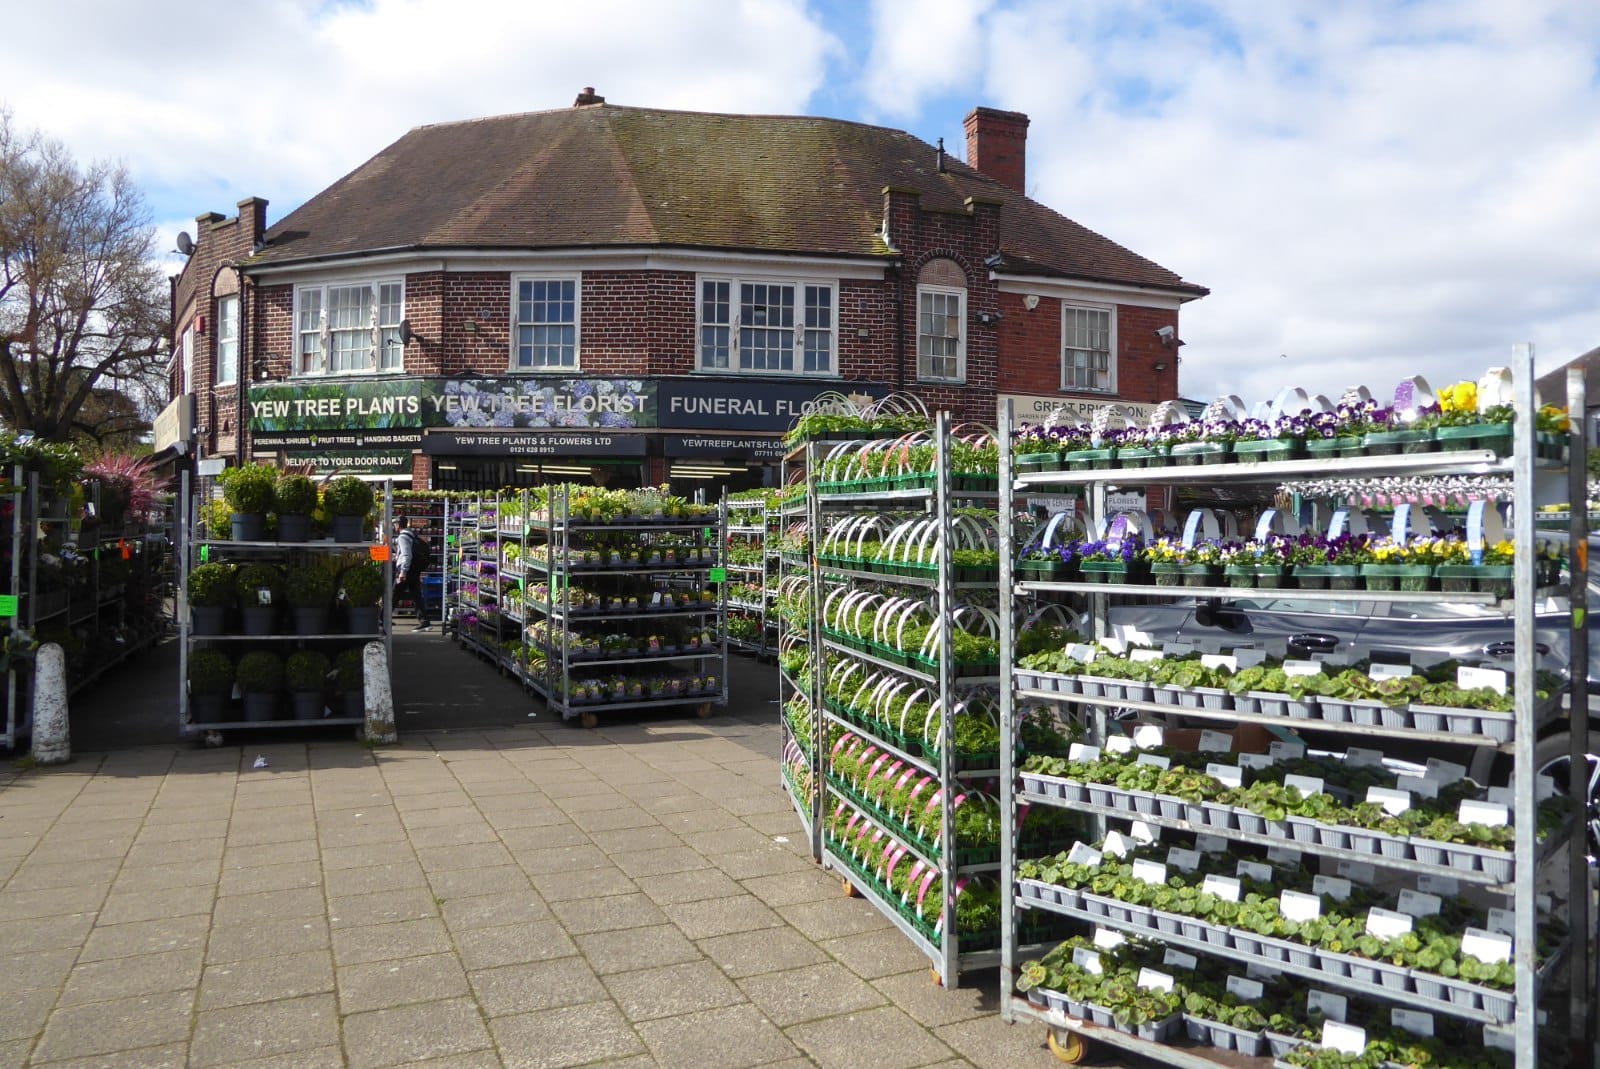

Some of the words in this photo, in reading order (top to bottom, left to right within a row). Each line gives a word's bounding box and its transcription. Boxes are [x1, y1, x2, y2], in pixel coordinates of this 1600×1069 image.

[251, 400, 290, 418] YEW
[294, 398, 341, 417] TREE
[346, 395, 419, 416] PLANTS
[431, 395, 480, 413] YEW
[489, 395, 545, 413] TREE
[554, 395, 648, 414] FLORIST
[670, 396, 770, 416] FUNERAL
[254, 438, 286, 446] PERENNIAL
[286, 437, 310, 445] SHRUBS
[336, 436, 356, 444] TREES
[364, 435, 392, 443] HANGING
[393, 434, 422, 442] BASKETS
[455, 437, 476, 446] YEW
[477, 437, 501, 446] TREE
[502, 437, 538, 446] PLANTS
[539, 437, 547, 446] &
[549, 437, 593, 446] FLOWERS
[594, 437, 612, 446] LTD
[318, 457, 330, 466] TO
[330, 457, 354, 466] YOUR
[354, 457, 379, 466] DOOR
[379, 456, 404, 465] DAILY
